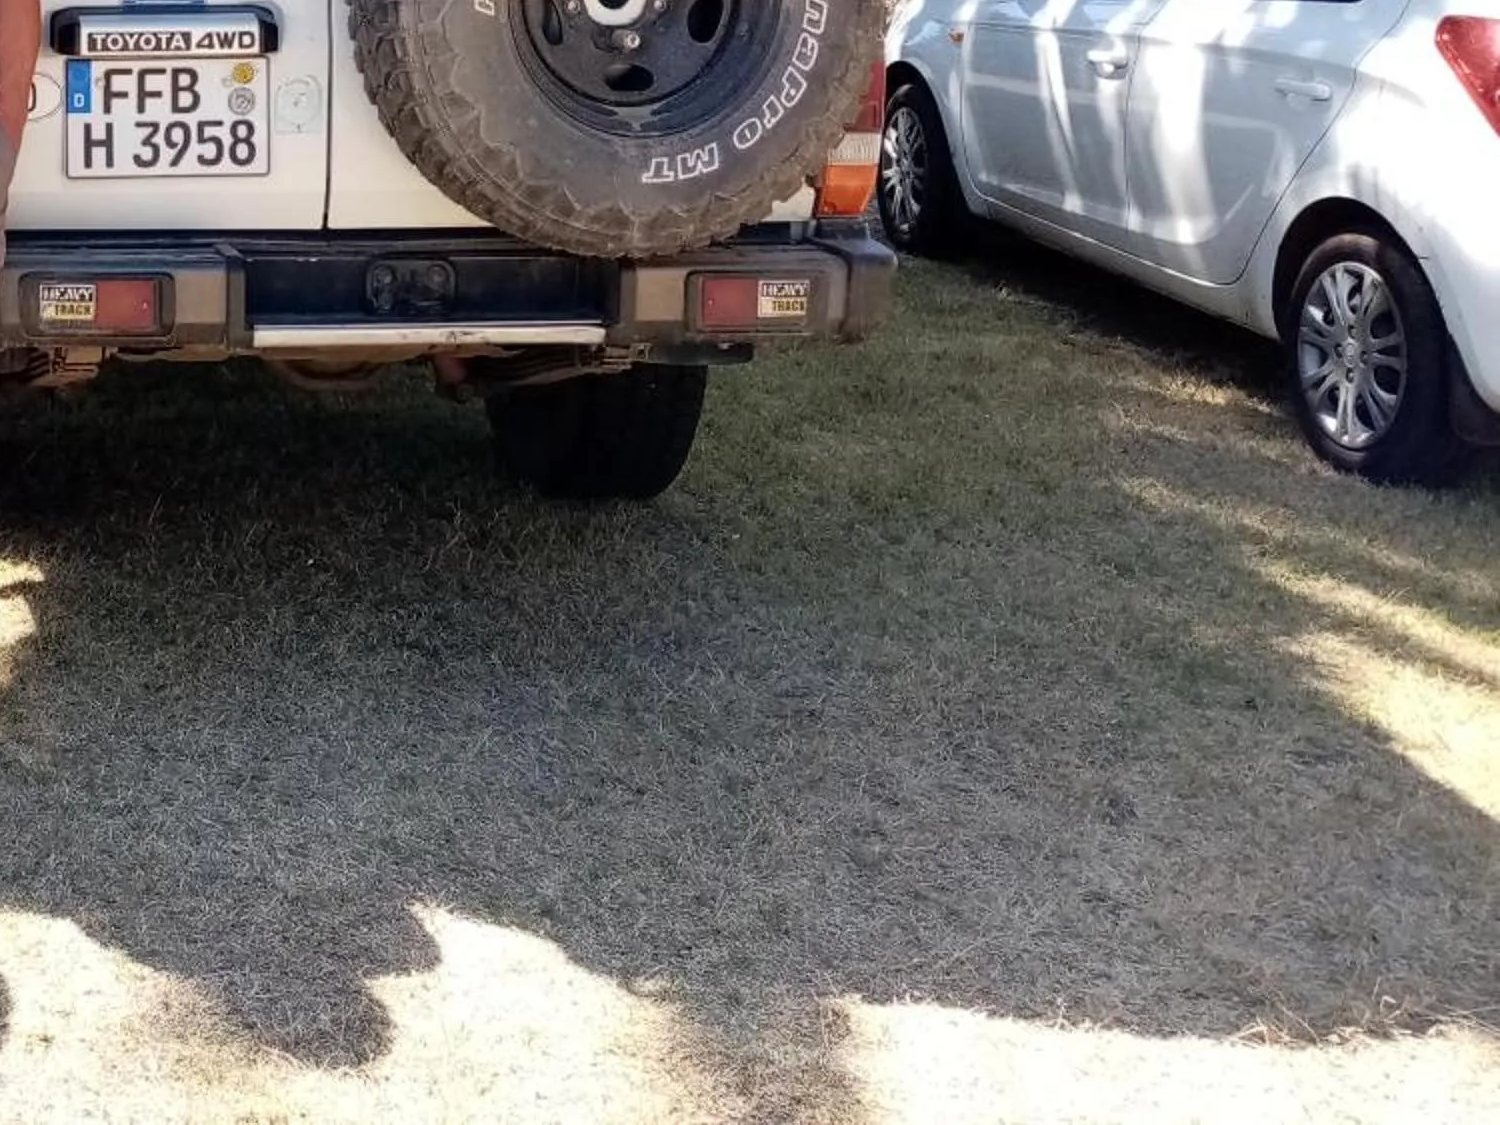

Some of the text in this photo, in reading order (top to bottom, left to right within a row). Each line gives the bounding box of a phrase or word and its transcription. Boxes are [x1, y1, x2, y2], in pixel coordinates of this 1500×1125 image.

[91, 31, 256, 51] TOYOTA 4WD
[102, 66, 202, 116] FFB
[72, 92, 86, 109] D
[83, 118, 258, 170] H 3958
[641, 141, 720, 183] MT
[42, 286, 93, 301] HEAVY
[762, 283, 806, 296] HEAVY
[54, 303, 92, 316] TRACK
